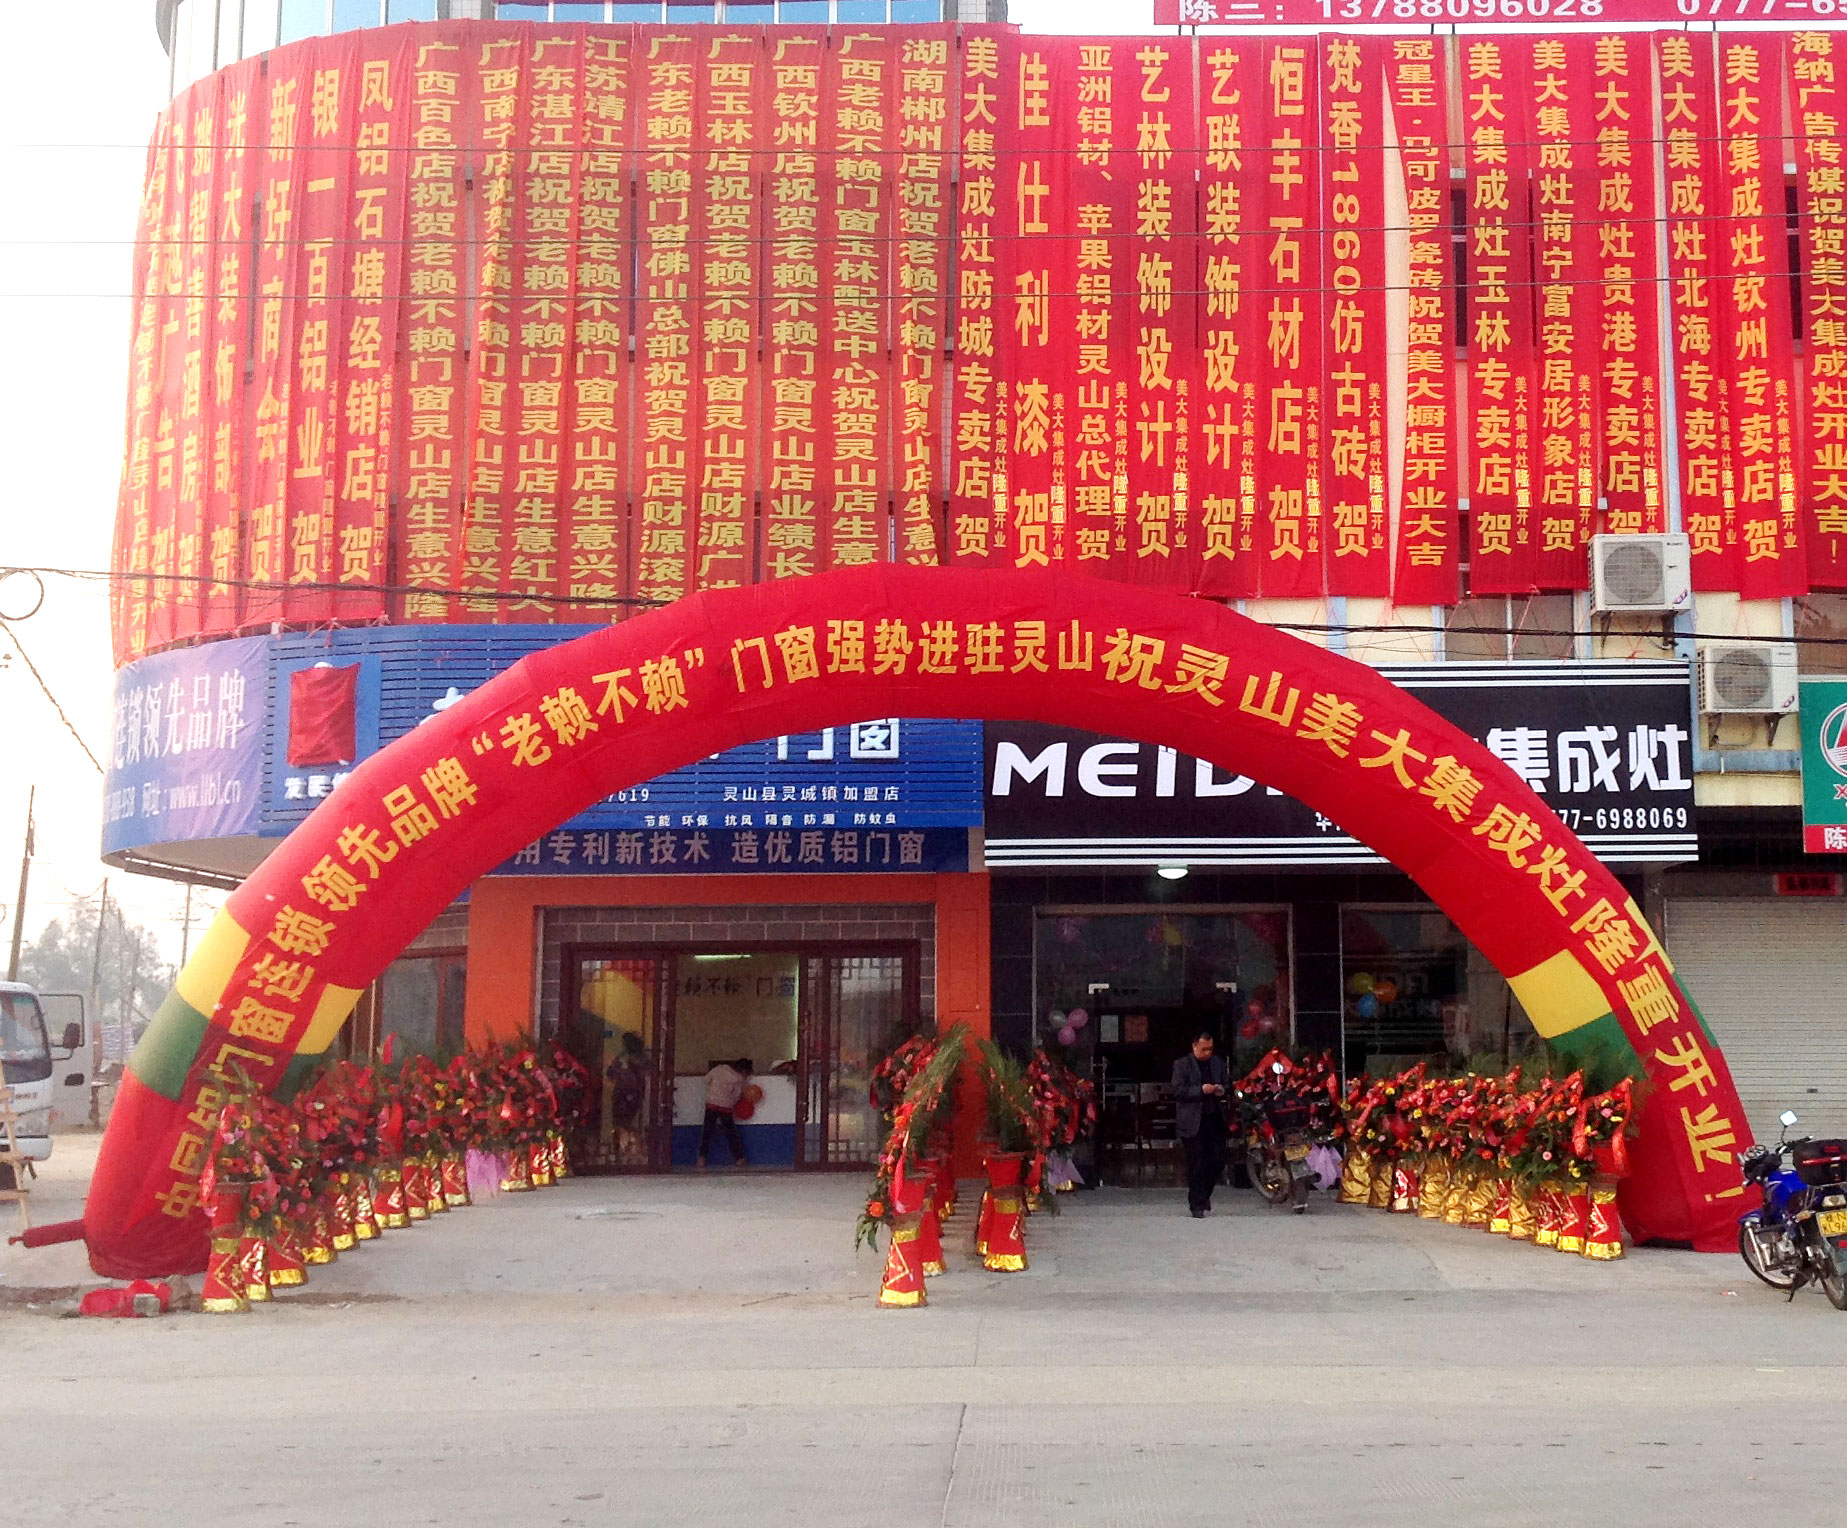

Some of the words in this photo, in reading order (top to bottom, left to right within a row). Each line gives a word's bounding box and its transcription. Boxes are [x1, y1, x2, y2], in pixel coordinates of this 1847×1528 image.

[289, 69, 340, 584] 银一百铝业贺
[339, 60, 393, 583] 凤铝石塘经销店贺
[403, 39, 458, 620] 广西百色店祝贺老赖不赖门窗灵山店生意兴隆
[992, 741, 1284, 797] MEID
[1474, 724, 1693, 793] 集成灶
[723, 785, 900, 802] 灵山县灵城镇加盟店
[1551, 807, 1688, 829] 77-6988069
[732, 831, 926, 866] 造优质铝门窗
